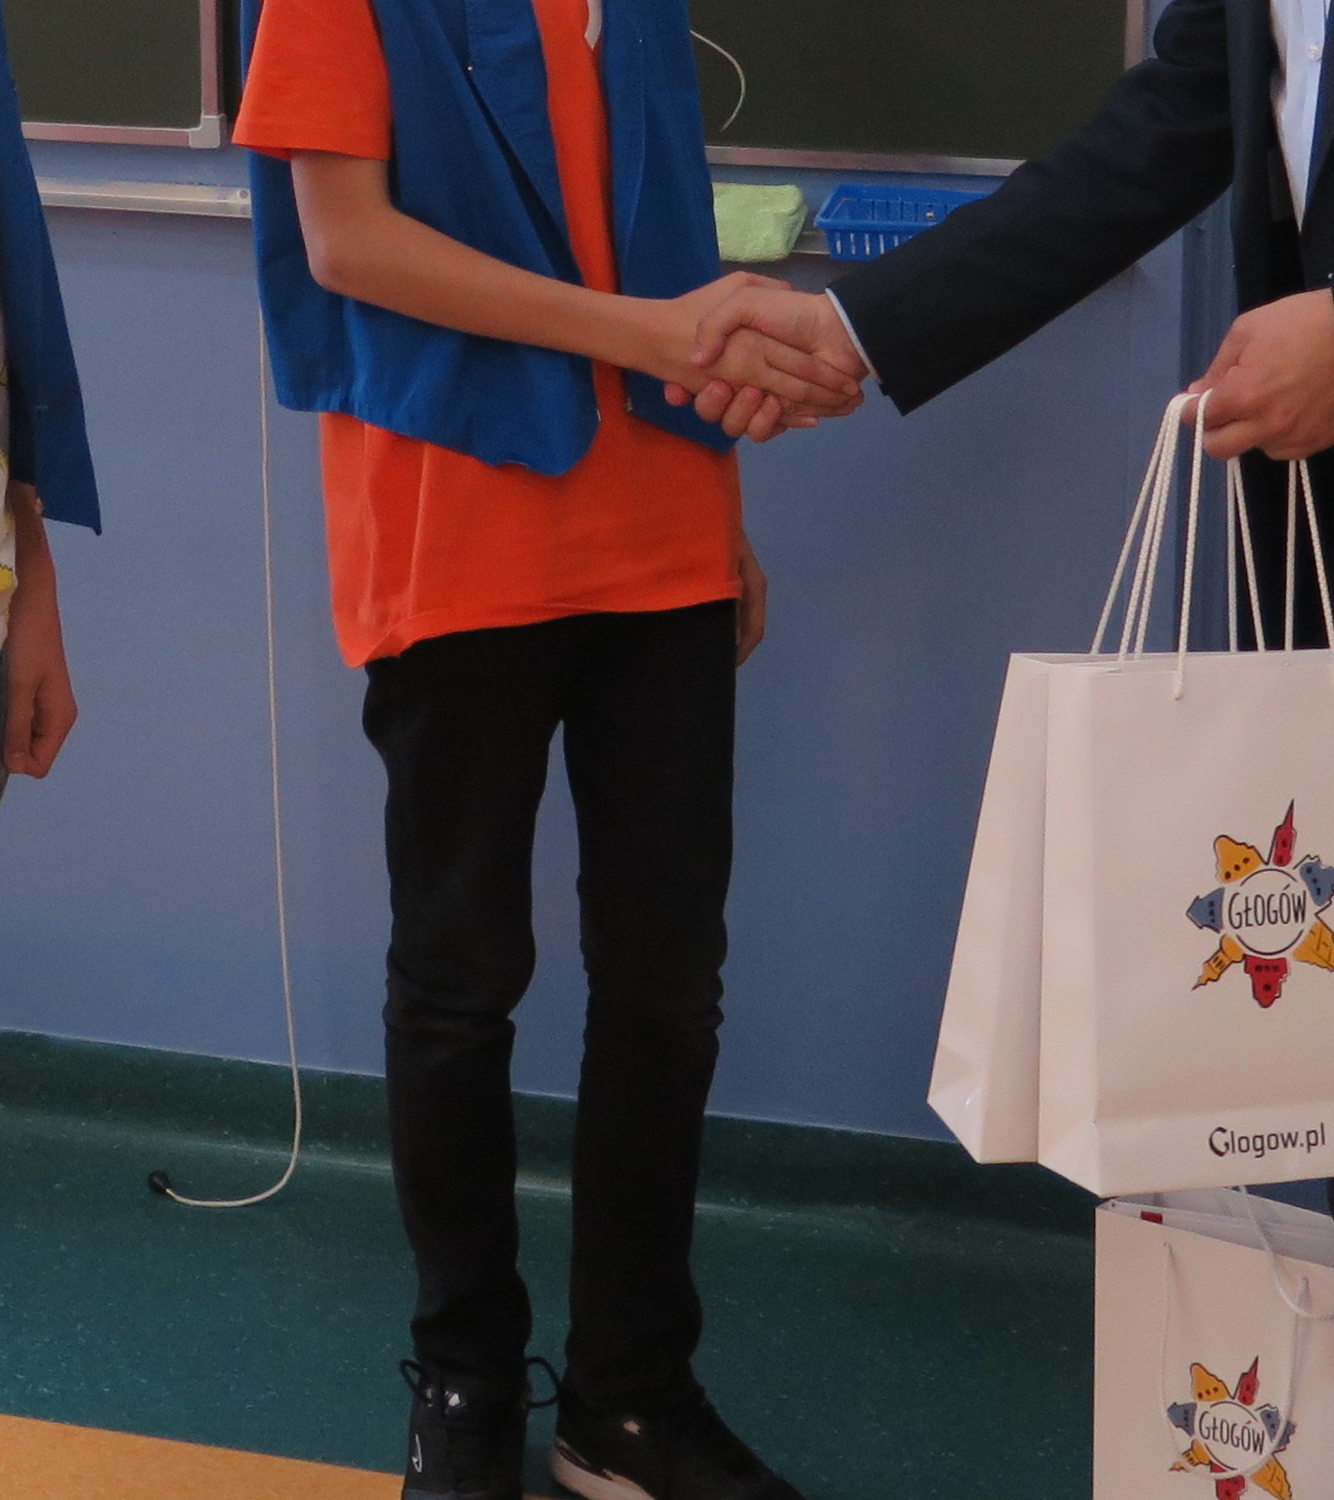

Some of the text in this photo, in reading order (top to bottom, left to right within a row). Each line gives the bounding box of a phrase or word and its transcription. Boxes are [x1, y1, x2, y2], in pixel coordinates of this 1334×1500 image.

[1226, 883, 1308, 930] GŁOGÓW
[1208, 1123, 1326, 1159] Glogow.pl
[1198, 1405, 1267, 1457] GŁOGÓW
